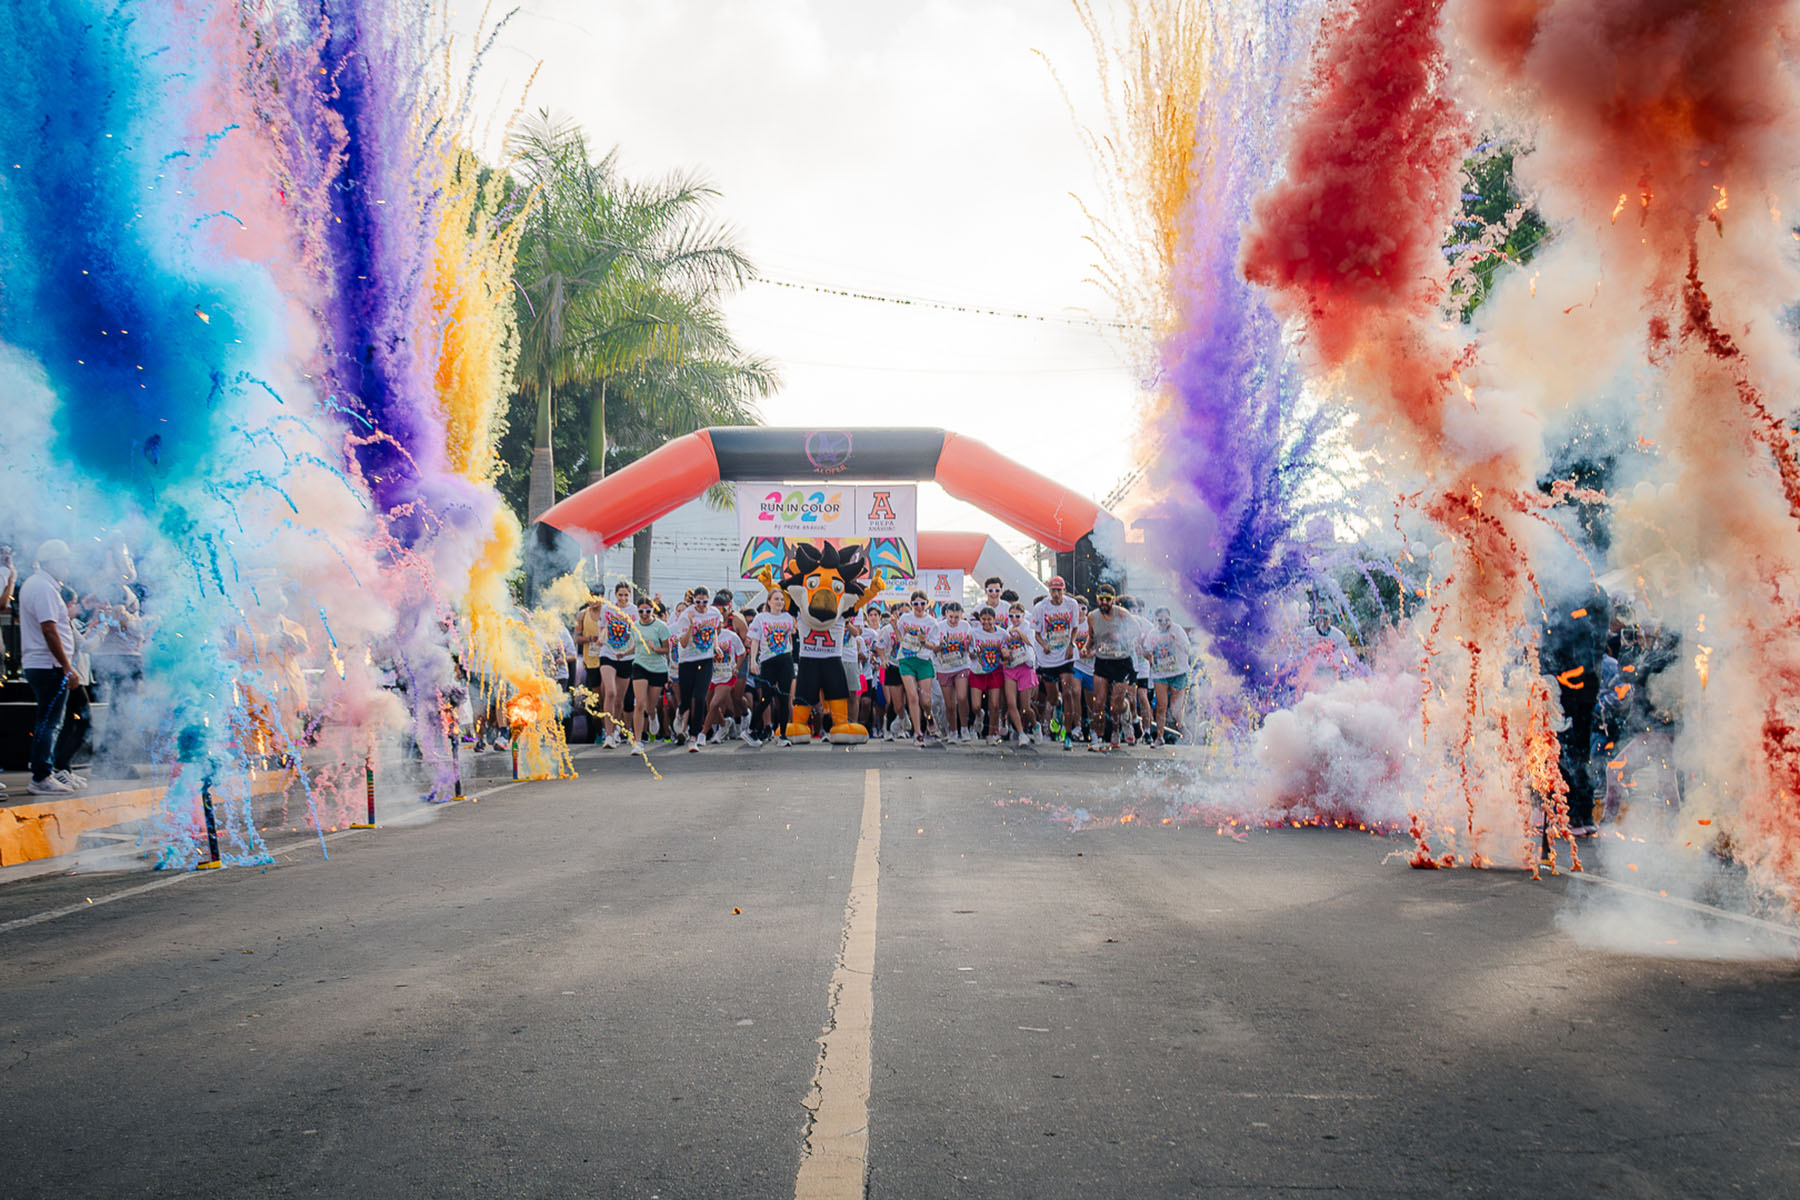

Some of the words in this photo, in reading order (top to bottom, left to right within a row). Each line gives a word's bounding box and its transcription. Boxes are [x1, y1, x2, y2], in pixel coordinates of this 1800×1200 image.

[760, 503, 784, 512] RUN
[786, 503, 799, 512] IN
[801, 503, 840, 513] COLOR
[868, 491, 896, 520] A
[934, 574, 951, 591] A
